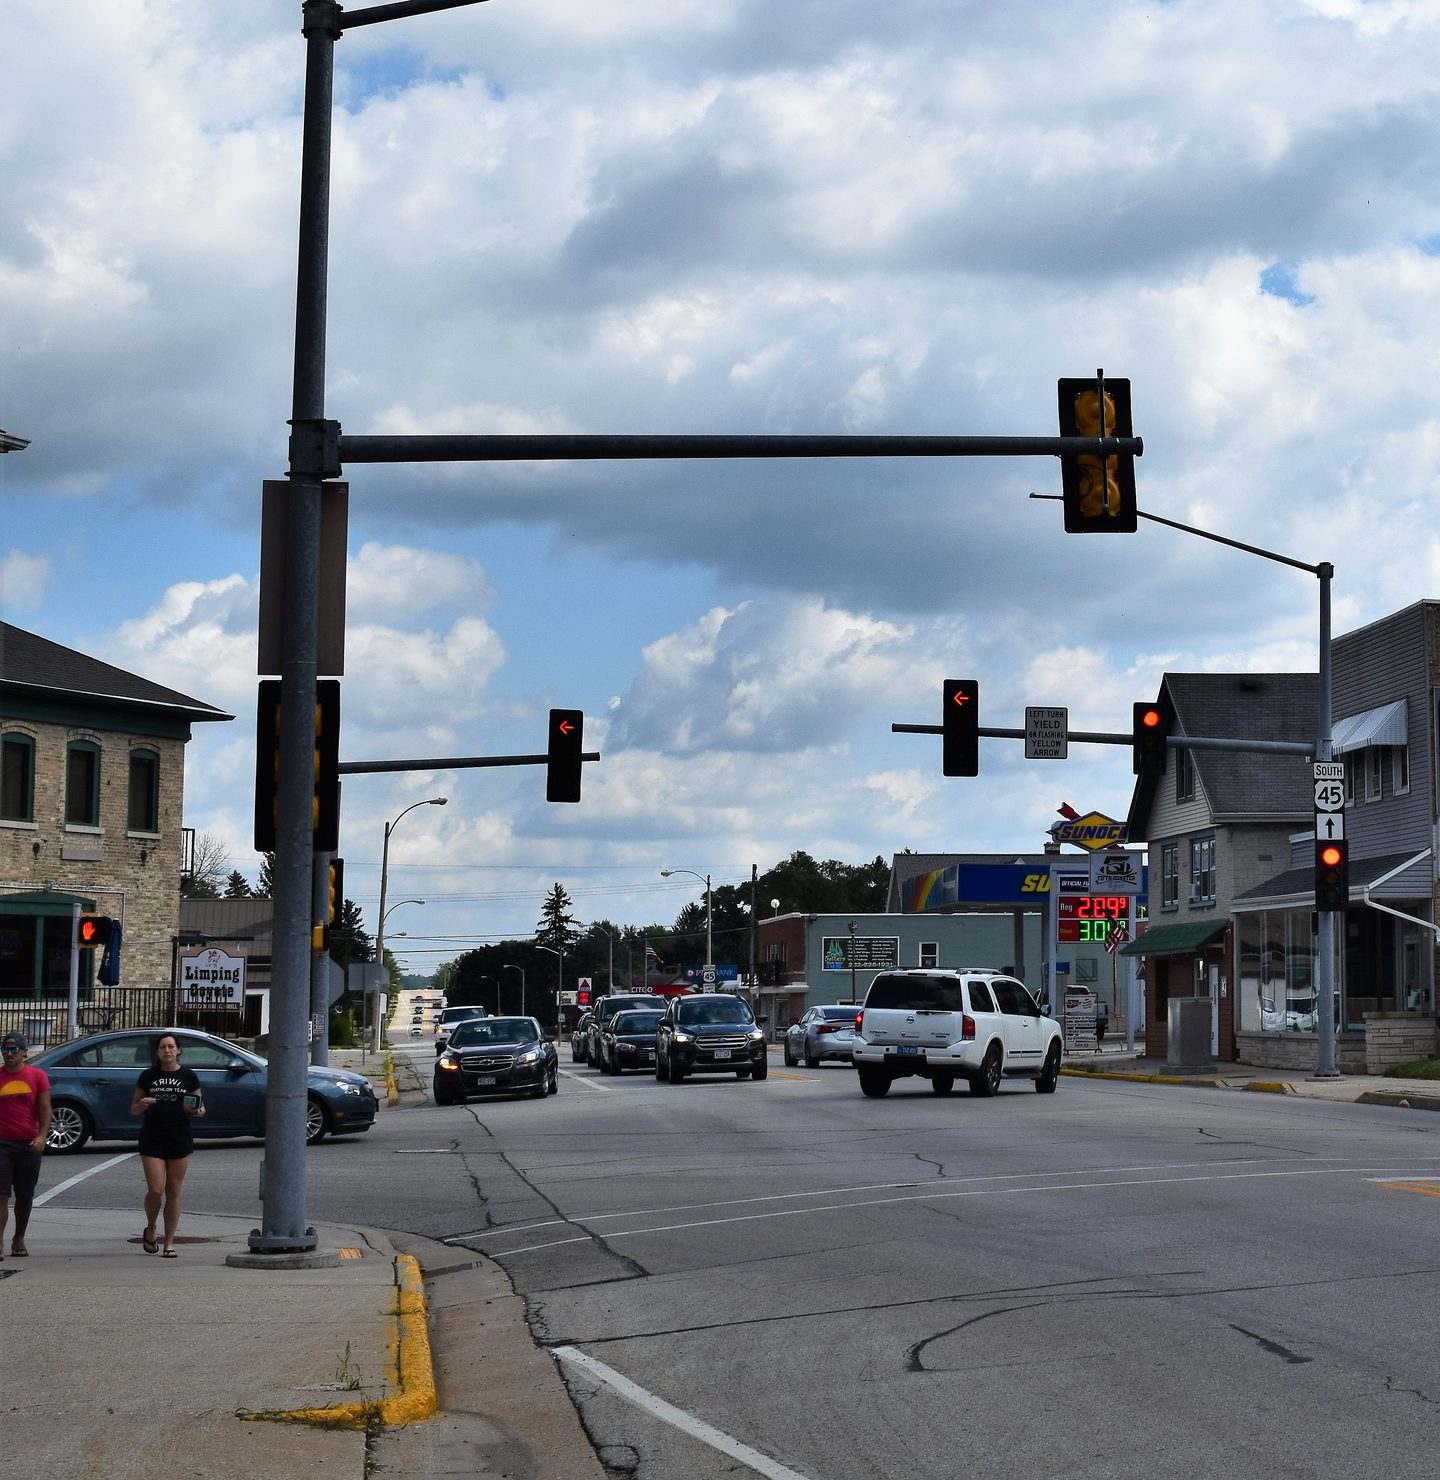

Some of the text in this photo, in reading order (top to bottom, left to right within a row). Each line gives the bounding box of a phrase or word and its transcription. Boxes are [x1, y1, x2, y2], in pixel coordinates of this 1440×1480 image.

[1034, 720, 1060, 729] YIELD
[1038, 731, 1064, 739] FLASHING
[1315, 765, 1343, 776] SOUTH
[1317, 786, 1342, 805] 45
[1060, 903, 1073, 912] Reg
[185, 966, 240, 983] Limping
[704, 972, 715, 981] 45
[631, 986, 653, 994] CITGO
[152, 1078, 182, 1087] TRIWI
